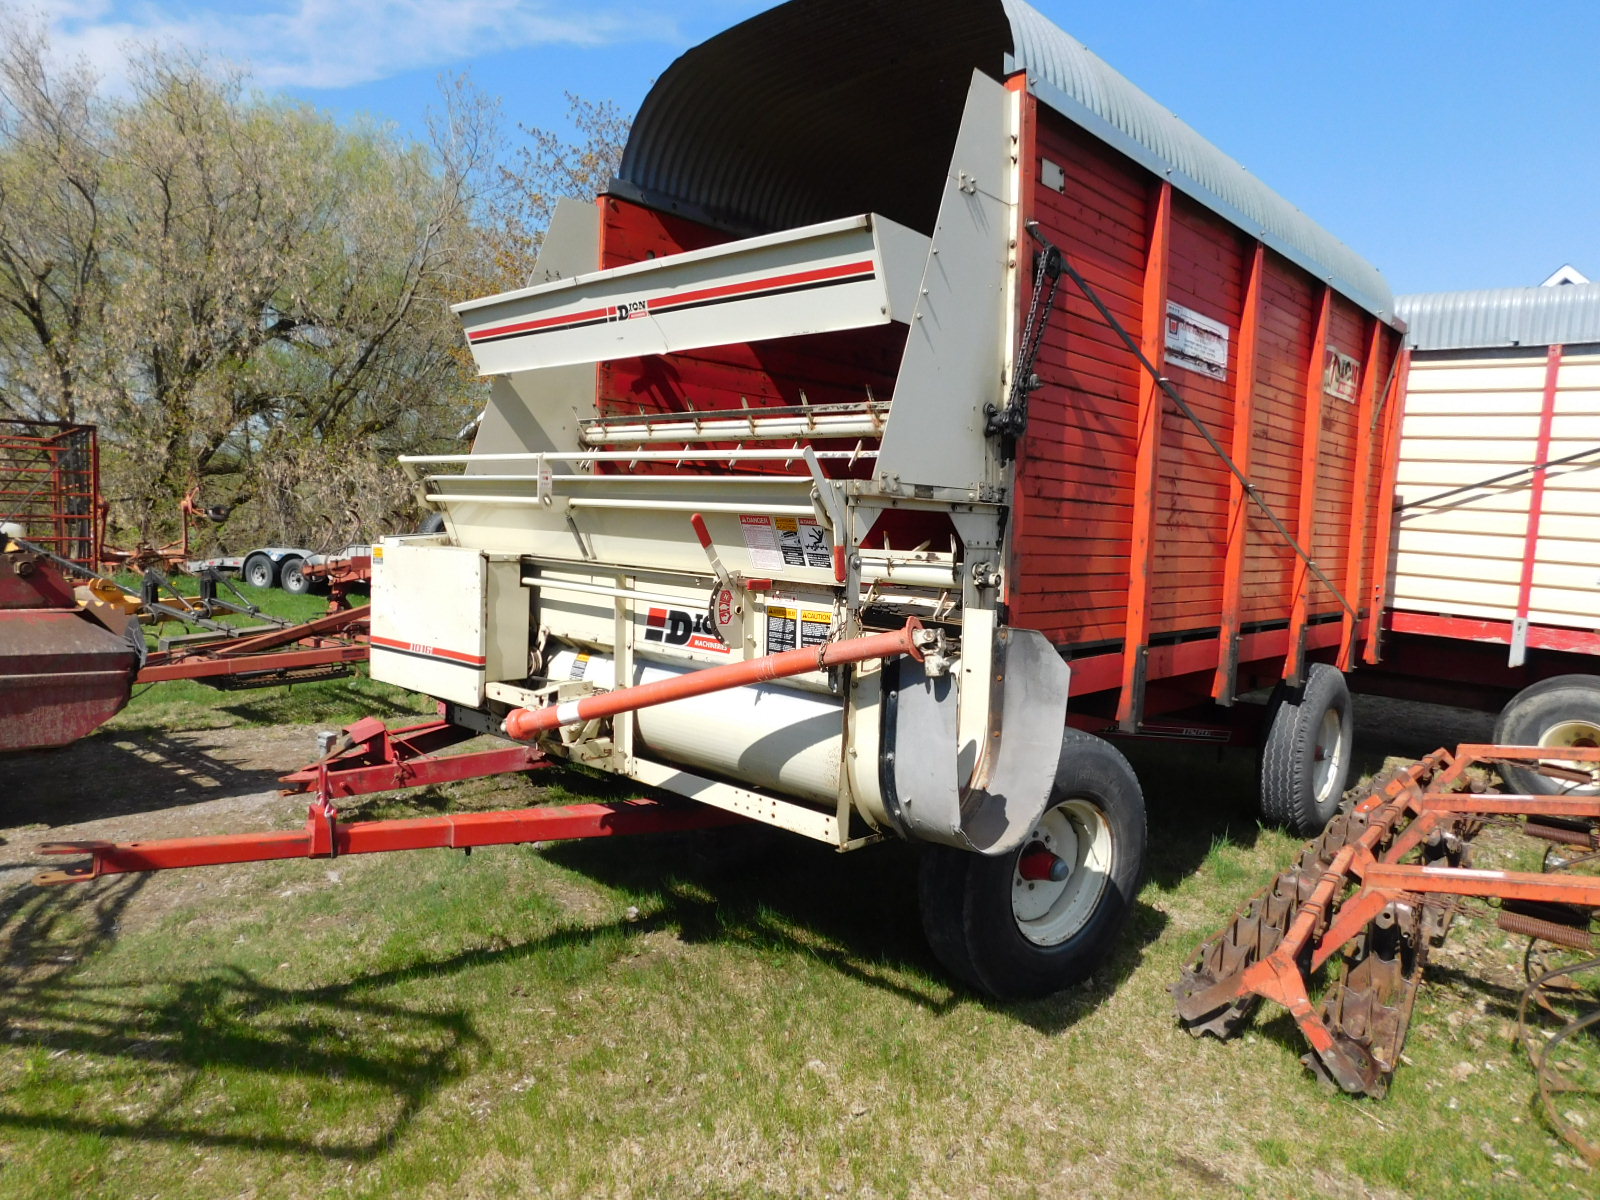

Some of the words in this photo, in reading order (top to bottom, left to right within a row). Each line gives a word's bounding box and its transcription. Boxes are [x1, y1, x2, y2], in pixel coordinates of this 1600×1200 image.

[617, 301, 646, 320] DION
[806, 613, 831, 621] CAUTION
[664, 610, 713, 646] DIO
[412, 643, 432, 654] 1016
